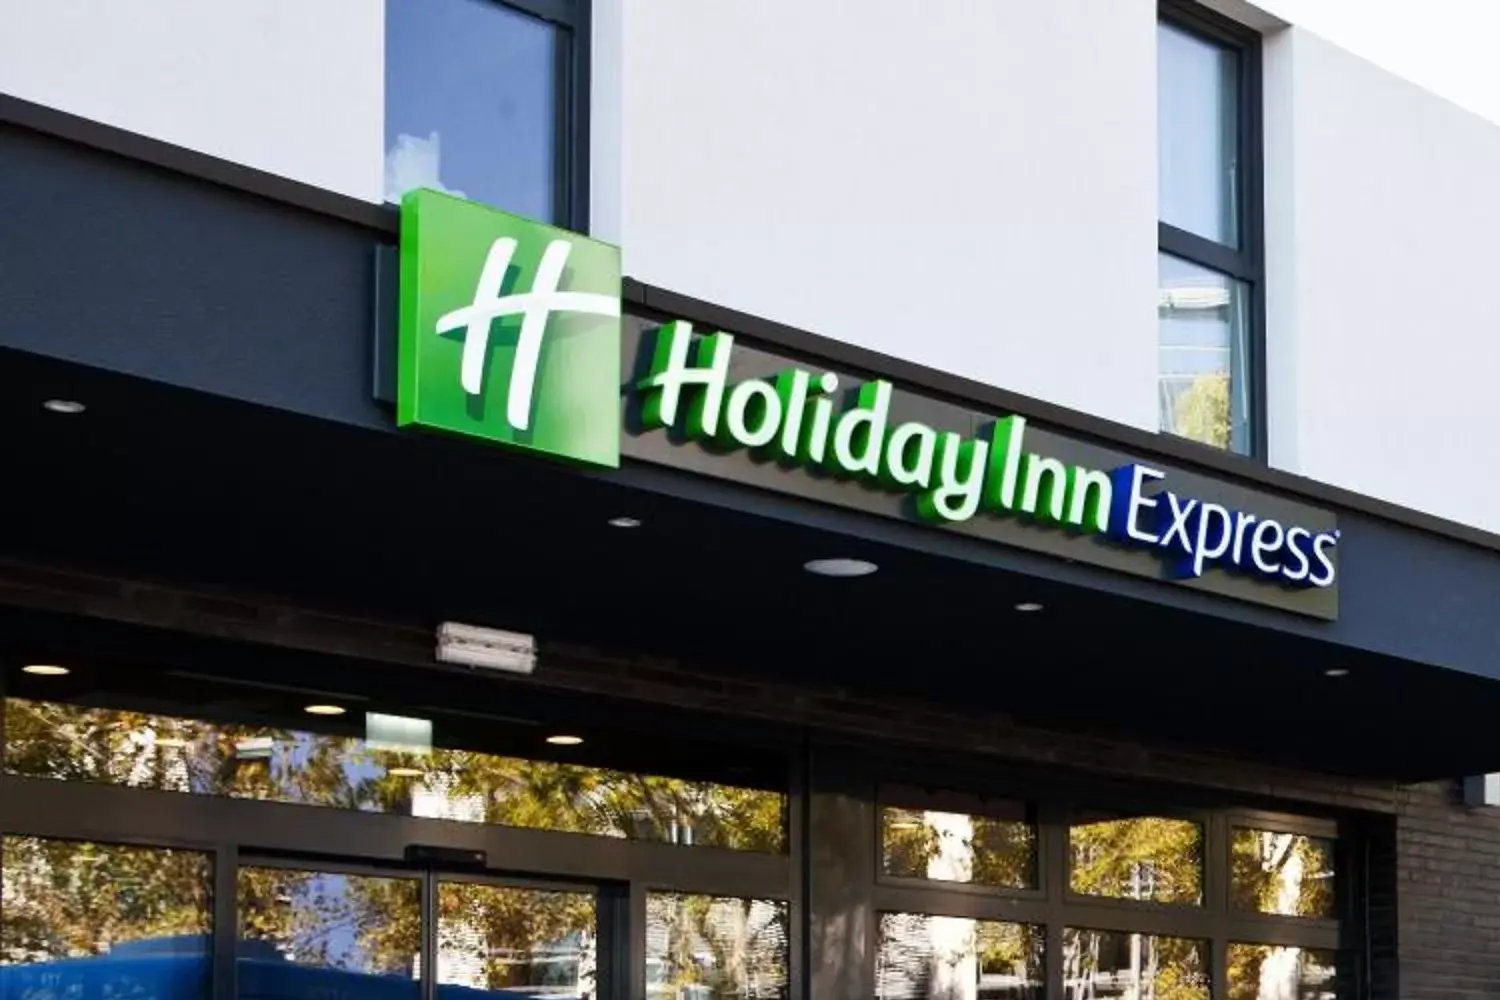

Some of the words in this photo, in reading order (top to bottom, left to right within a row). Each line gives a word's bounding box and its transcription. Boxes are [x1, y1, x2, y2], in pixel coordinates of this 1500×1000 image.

[436, 237, 621, 430] H
[648, 319, 989, 521] Holiday
[998, 414, 1112, 533] Inn
[1127, 464, 1340, 586] Express
